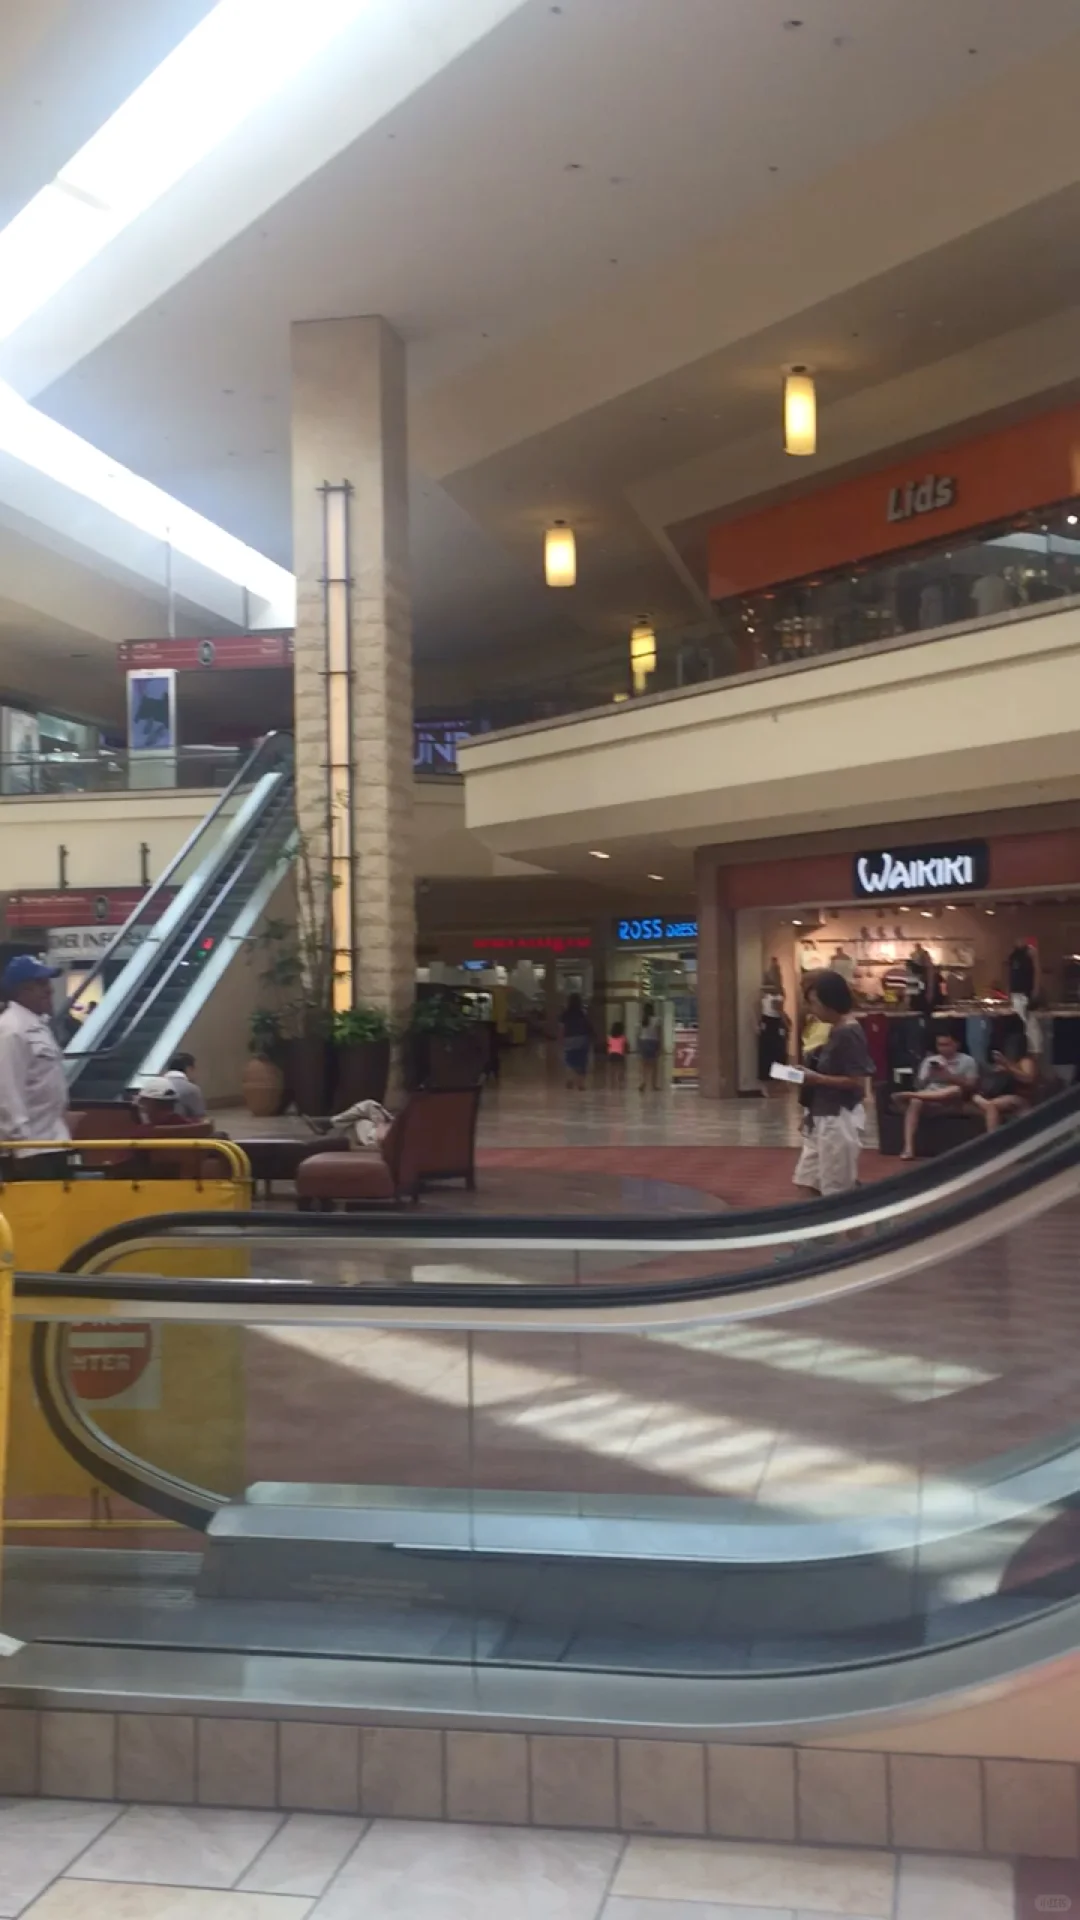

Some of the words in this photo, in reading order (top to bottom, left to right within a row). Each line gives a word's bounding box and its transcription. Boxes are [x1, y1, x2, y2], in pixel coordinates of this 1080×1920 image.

[886, 474, 954, 522] Lids
[857, 852, 973, 892] WAIKIKI
[617, 919, 662, 940] ROSS
